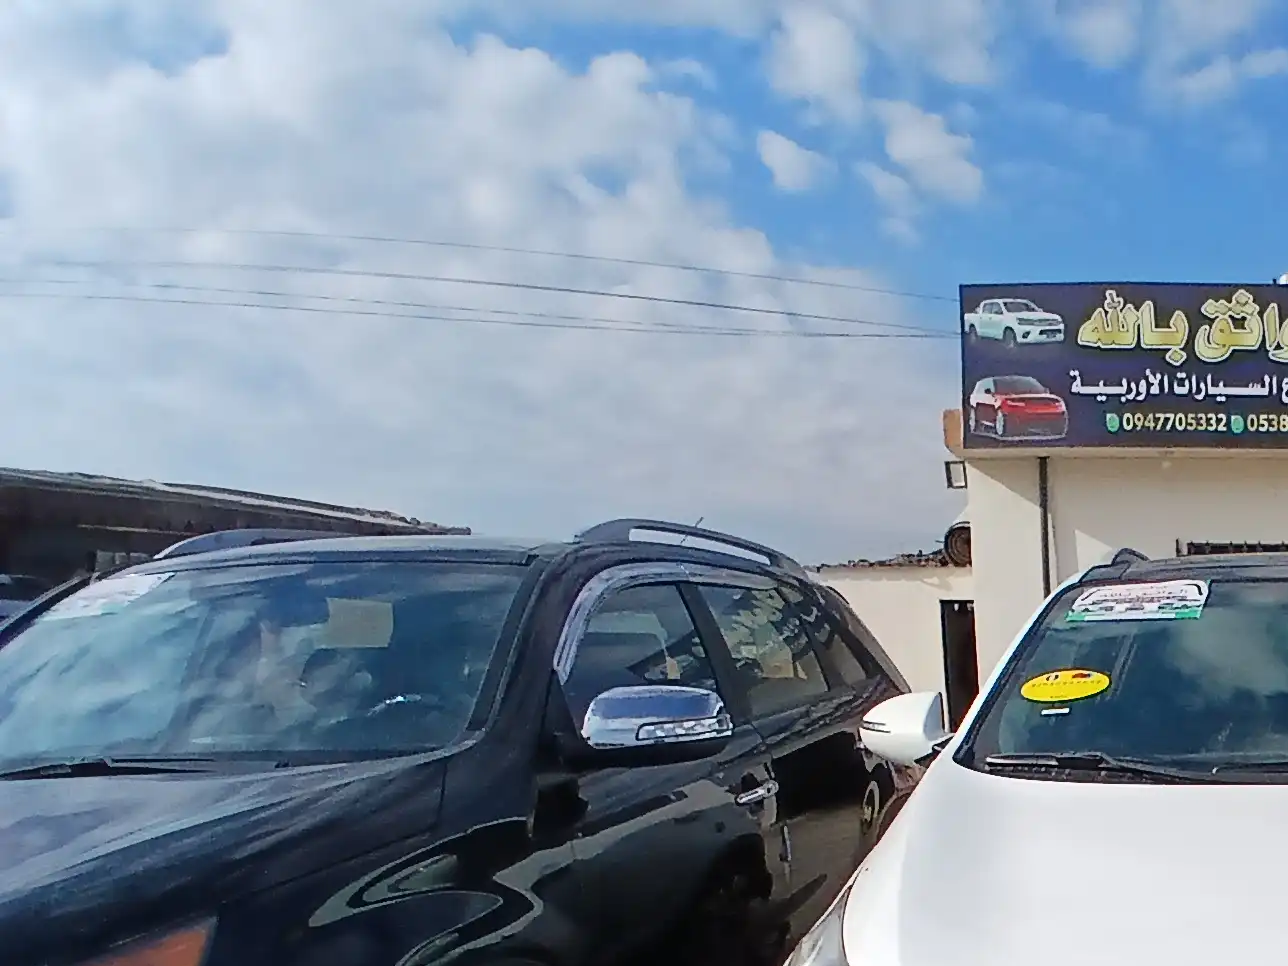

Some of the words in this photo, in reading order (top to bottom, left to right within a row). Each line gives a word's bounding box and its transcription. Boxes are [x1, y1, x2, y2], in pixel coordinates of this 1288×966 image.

[1078, 290, 1189, 366] بالله
[1069, 368, 1169, 402] الأوربية
[1173, 372, 1277, 402] السيارات
[1122, 412, 1227, 432] 0947705332
